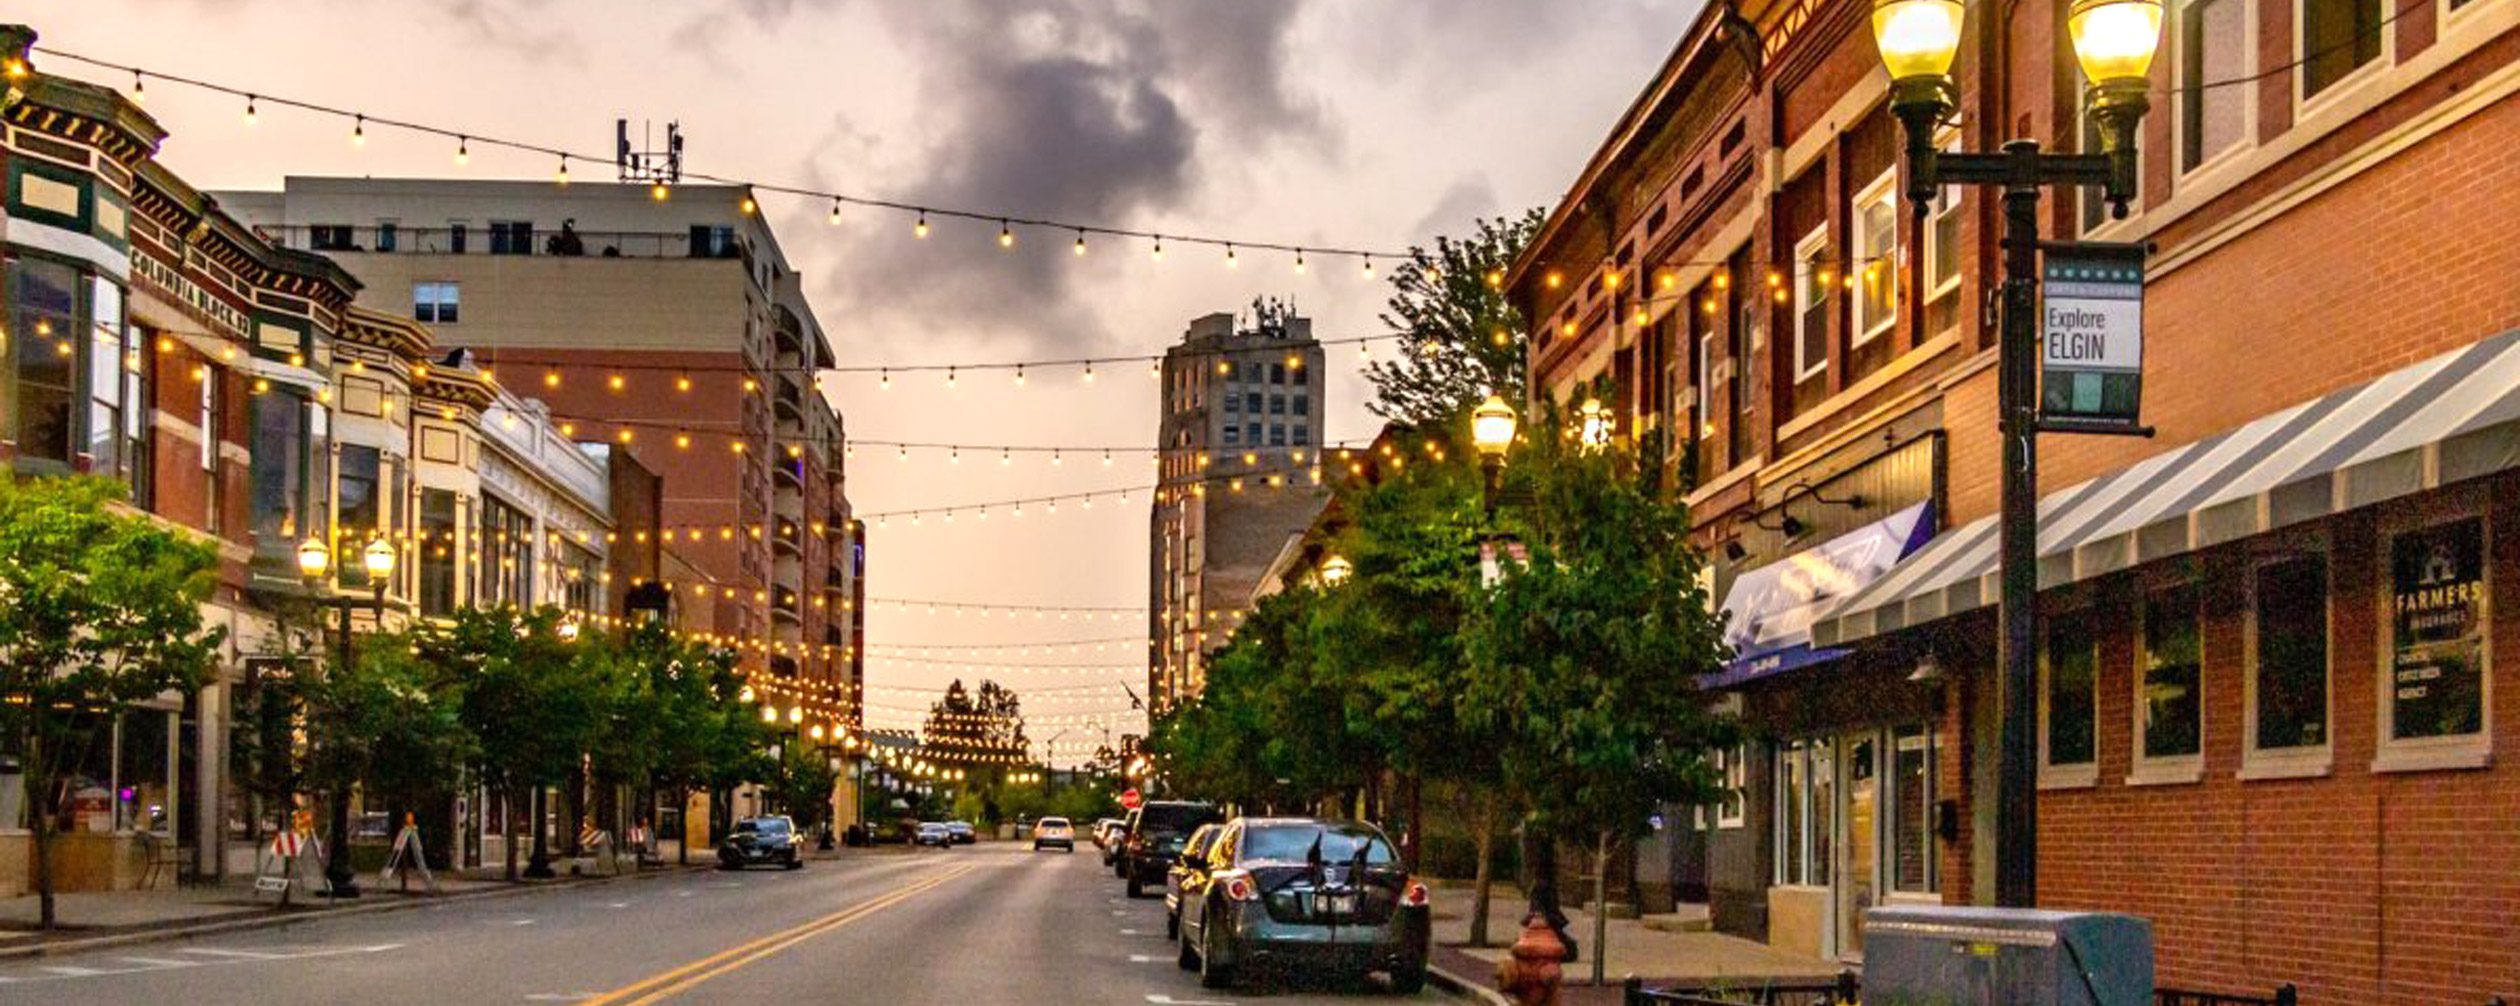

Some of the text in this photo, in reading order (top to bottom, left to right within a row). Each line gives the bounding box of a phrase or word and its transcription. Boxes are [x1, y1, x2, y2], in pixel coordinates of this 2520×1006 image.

[131, 248, 194, 303] COLUMBIA
[198, 288, 233, 326] BLOCK
[2049, 307, 2106, 331] Explore
[2049, 332, 2105, 360] ELGIN
[2397, 581, 2482, 614] FARMERS
